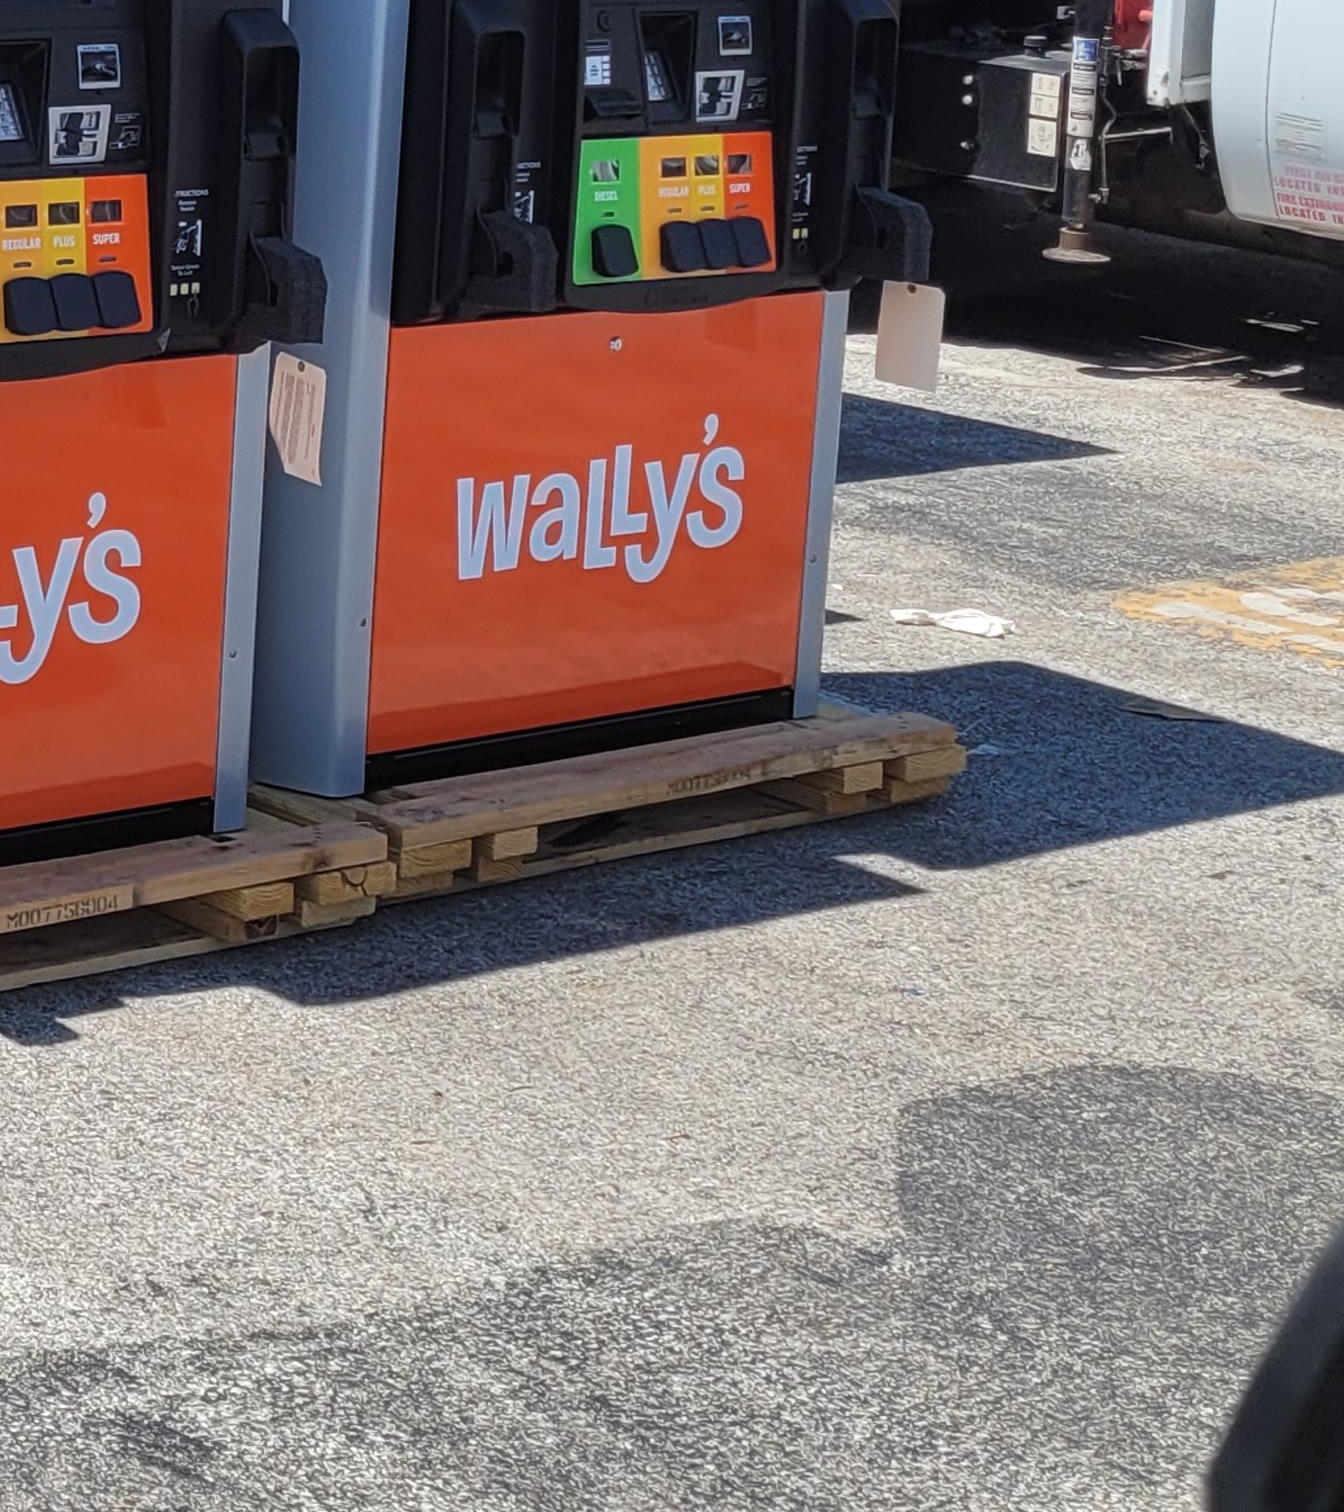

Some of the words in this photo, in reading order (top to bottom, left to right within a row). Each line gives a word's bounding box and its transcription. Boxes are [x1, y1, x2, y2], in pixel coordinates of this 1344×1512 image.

[1278, 204, 1326, 222] LOCATED
[2, 237, 41, 251] REGULAR
[53, 235, 76, 248] PLUS
[92, 232, 120, 246] SUPER
